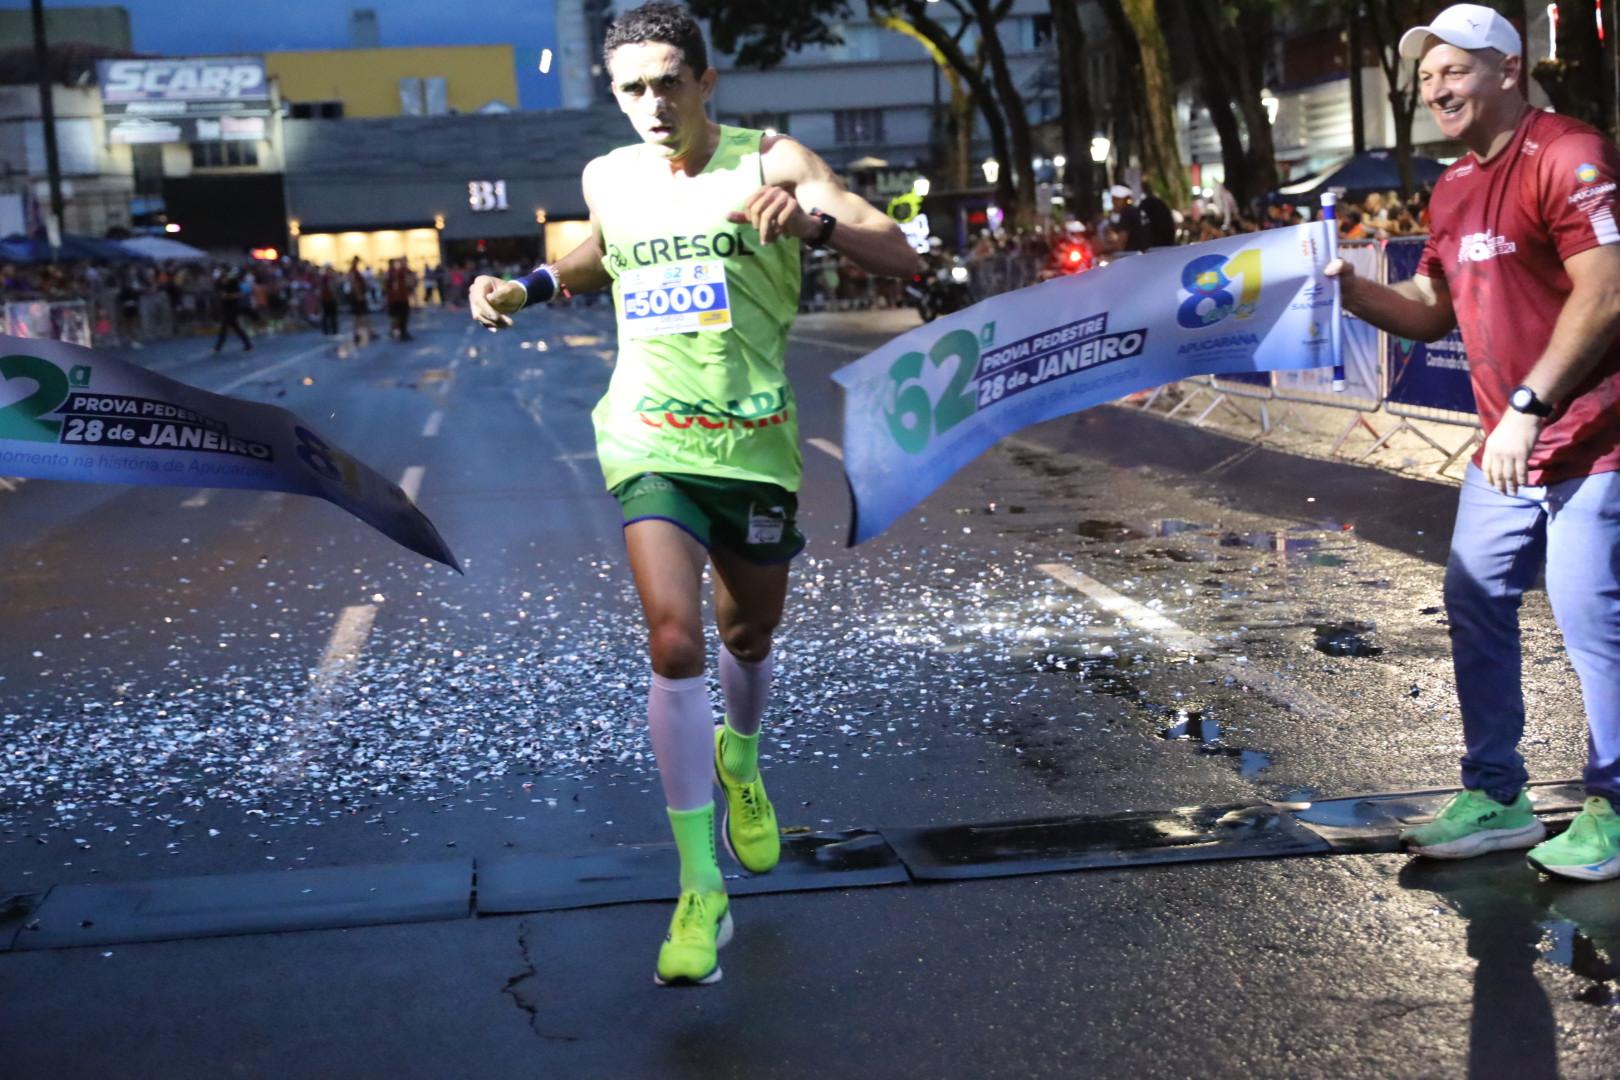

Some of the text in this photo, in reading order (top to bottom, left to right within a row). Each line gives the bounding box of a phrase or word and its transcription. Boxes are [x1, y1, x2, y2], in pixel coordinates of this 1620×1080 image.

[104, 60, 263, 99] SCARP
[633, 231, 755, 266] CRESOL
[634, 284, 716, 317] 5000
[1177, 248, 1263, 329] 81
[981, 317, 1105, 372] PROVA PEDESTRE
[979, 374, 1007, 406] 28
[1007, 371, 1029, 390] de
[1030, 333, 1142, 384] JANEIRO
[73, 397, 225, 429] PROVA PEDES
[64, 418, 270, 459] 28 de JANEIRO
[0, 451, 69, 466] omento
[73, 456, 95, 468] na
[166, 456, 186, 472] de
